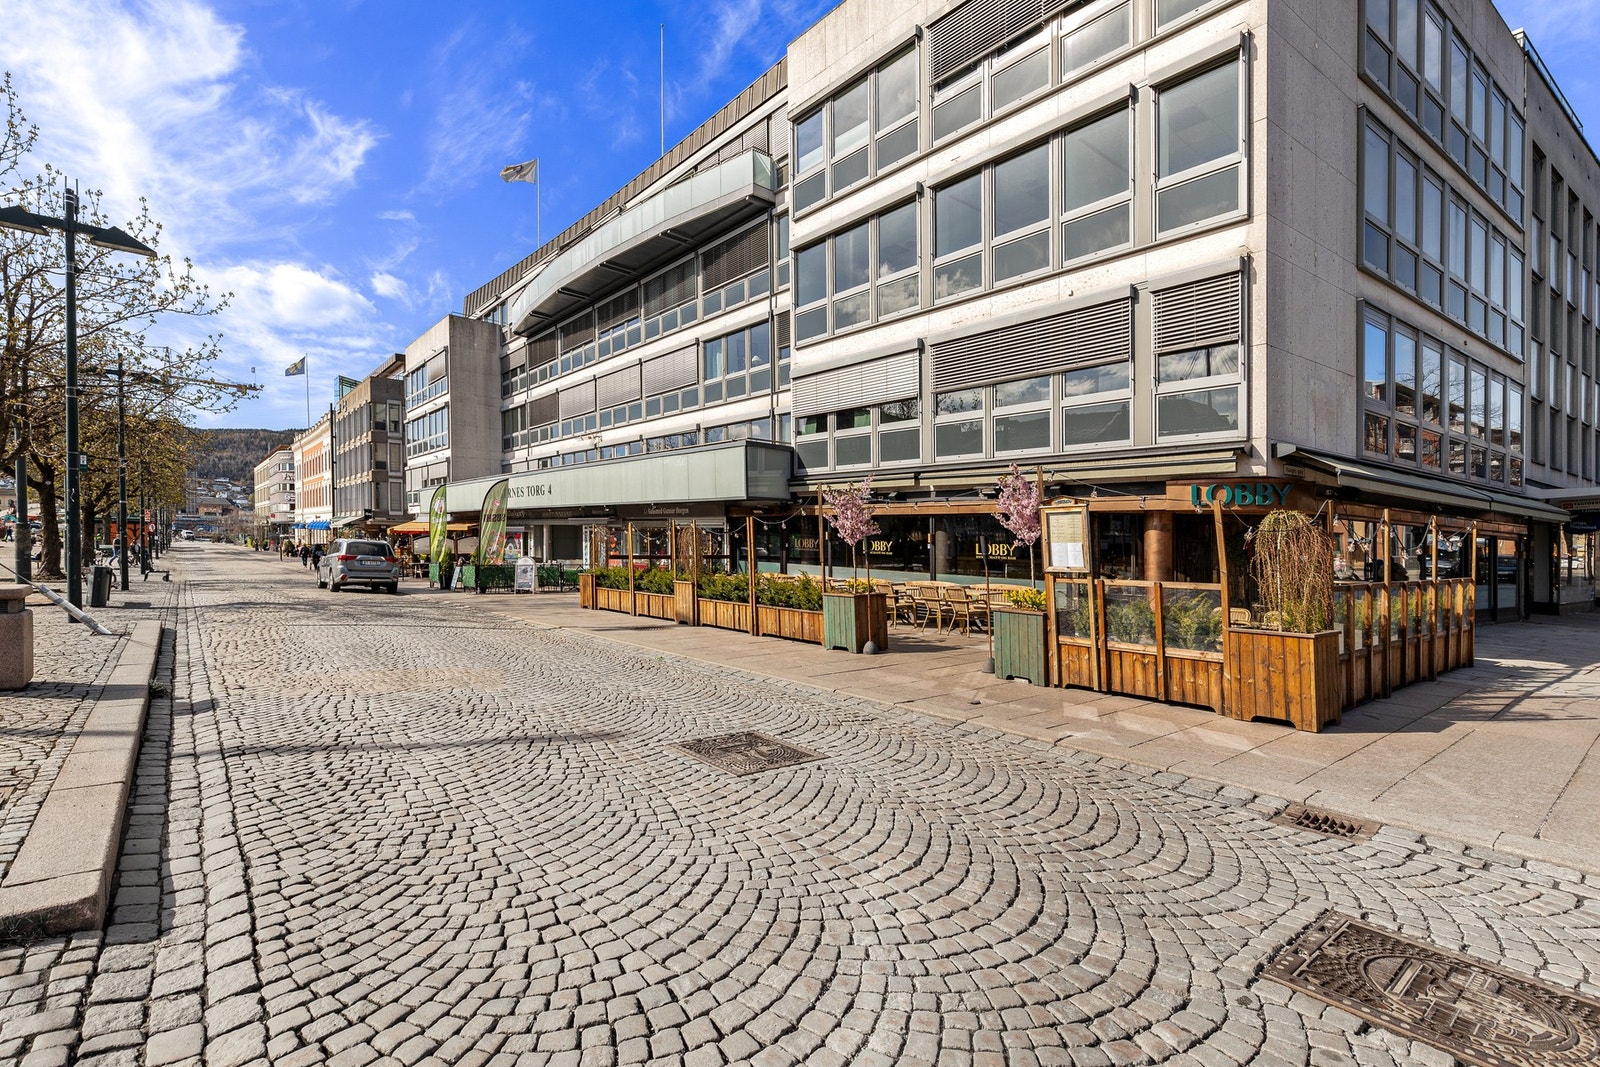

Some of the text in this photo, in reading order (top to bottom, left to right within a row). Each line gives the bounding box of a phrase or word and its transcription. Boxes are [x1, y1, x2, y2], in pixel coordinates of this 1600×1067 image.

[527, 484, 545, 497] TORG
[548, 483, 552, 495] 4
[1190, 483, 1294, 506] LOBBY
[794, 538, 819, 548] LOBBY
